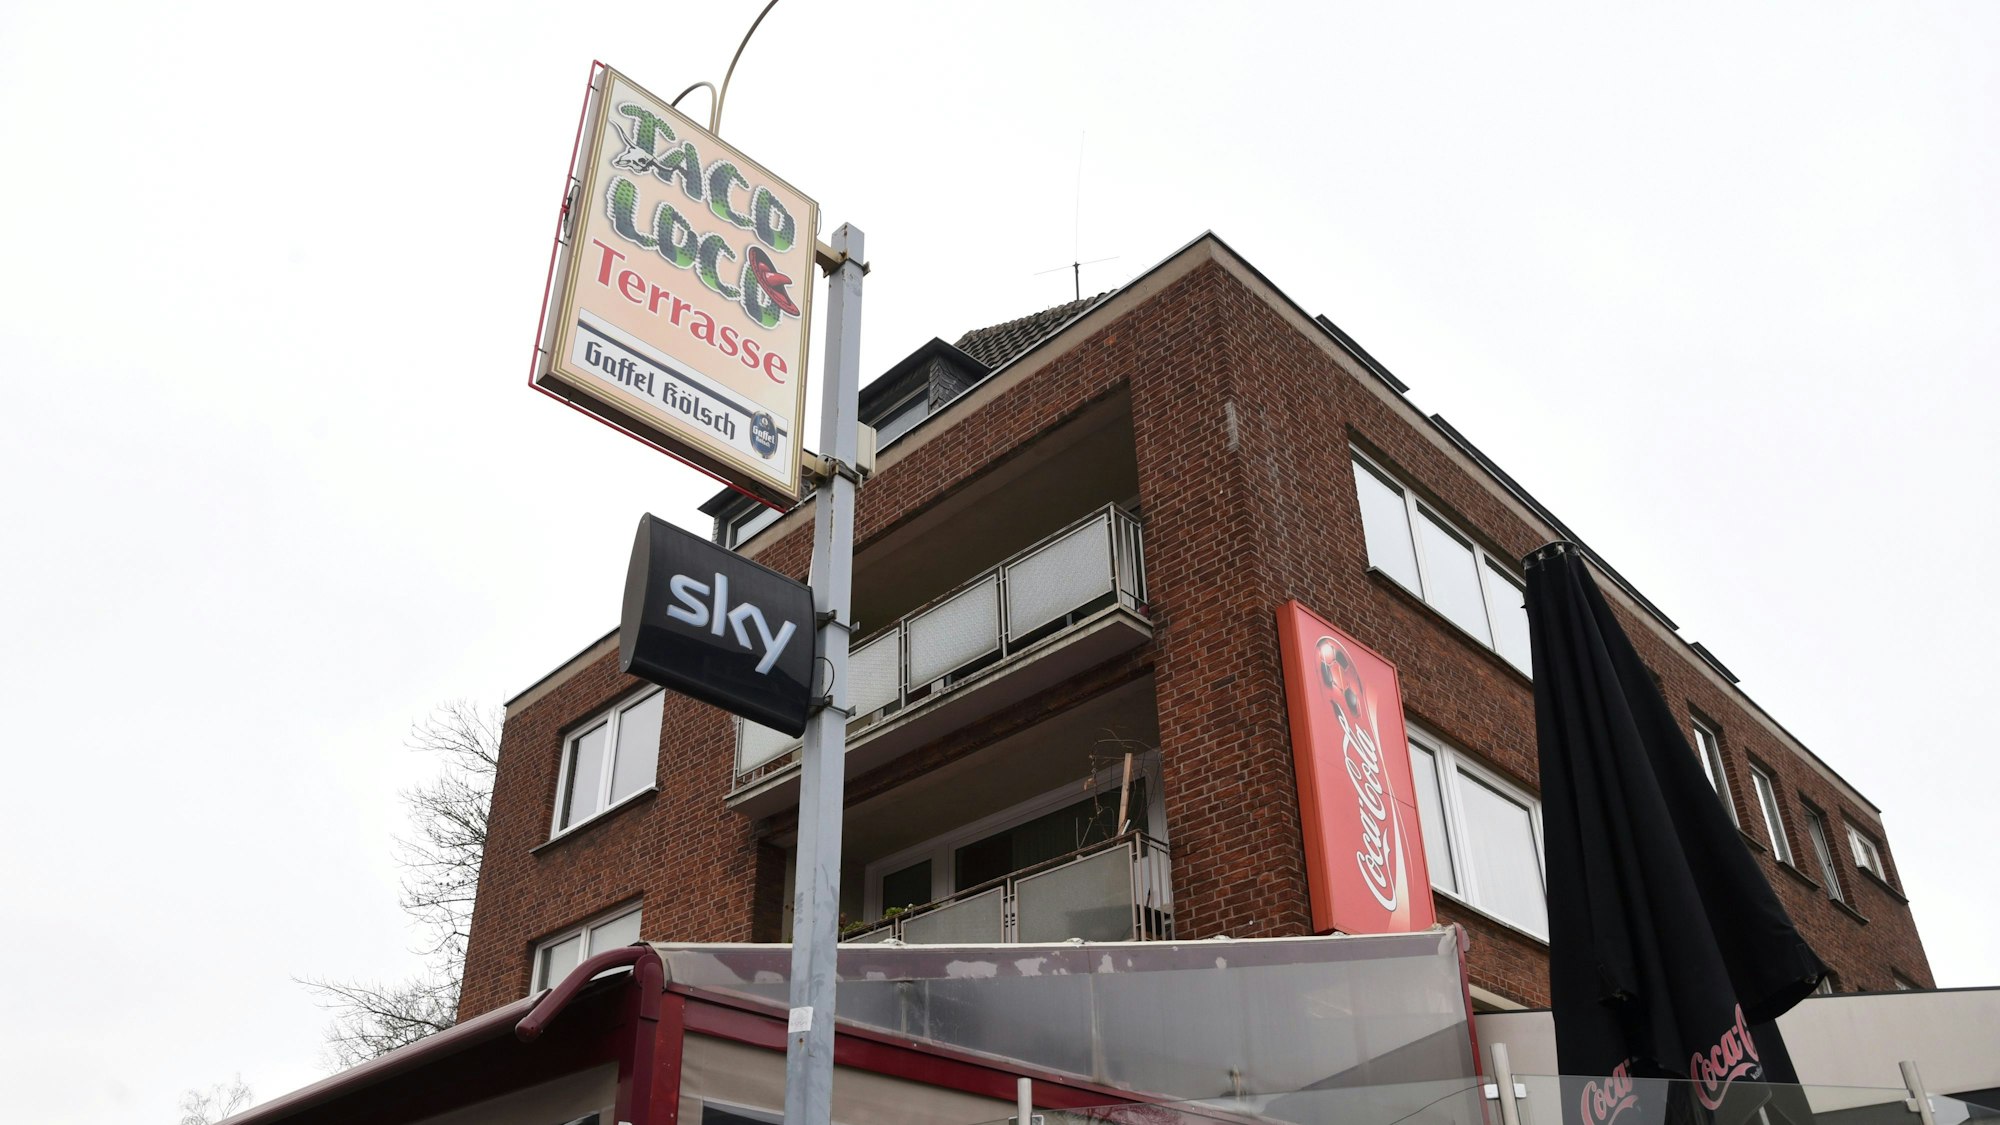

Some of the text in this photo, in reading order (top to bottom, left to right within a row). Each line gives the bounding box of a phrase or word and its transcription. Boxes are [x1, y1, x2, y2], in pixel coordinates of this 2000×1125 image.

[619, 103, 796, 252] TACO
[593, 238, 788, 384] Terrasse
[606, 176, 784, 330] LOCO
[585, 341, 736, 440] Gaffel Kölsch
[666, 572, 797, 675] sky
